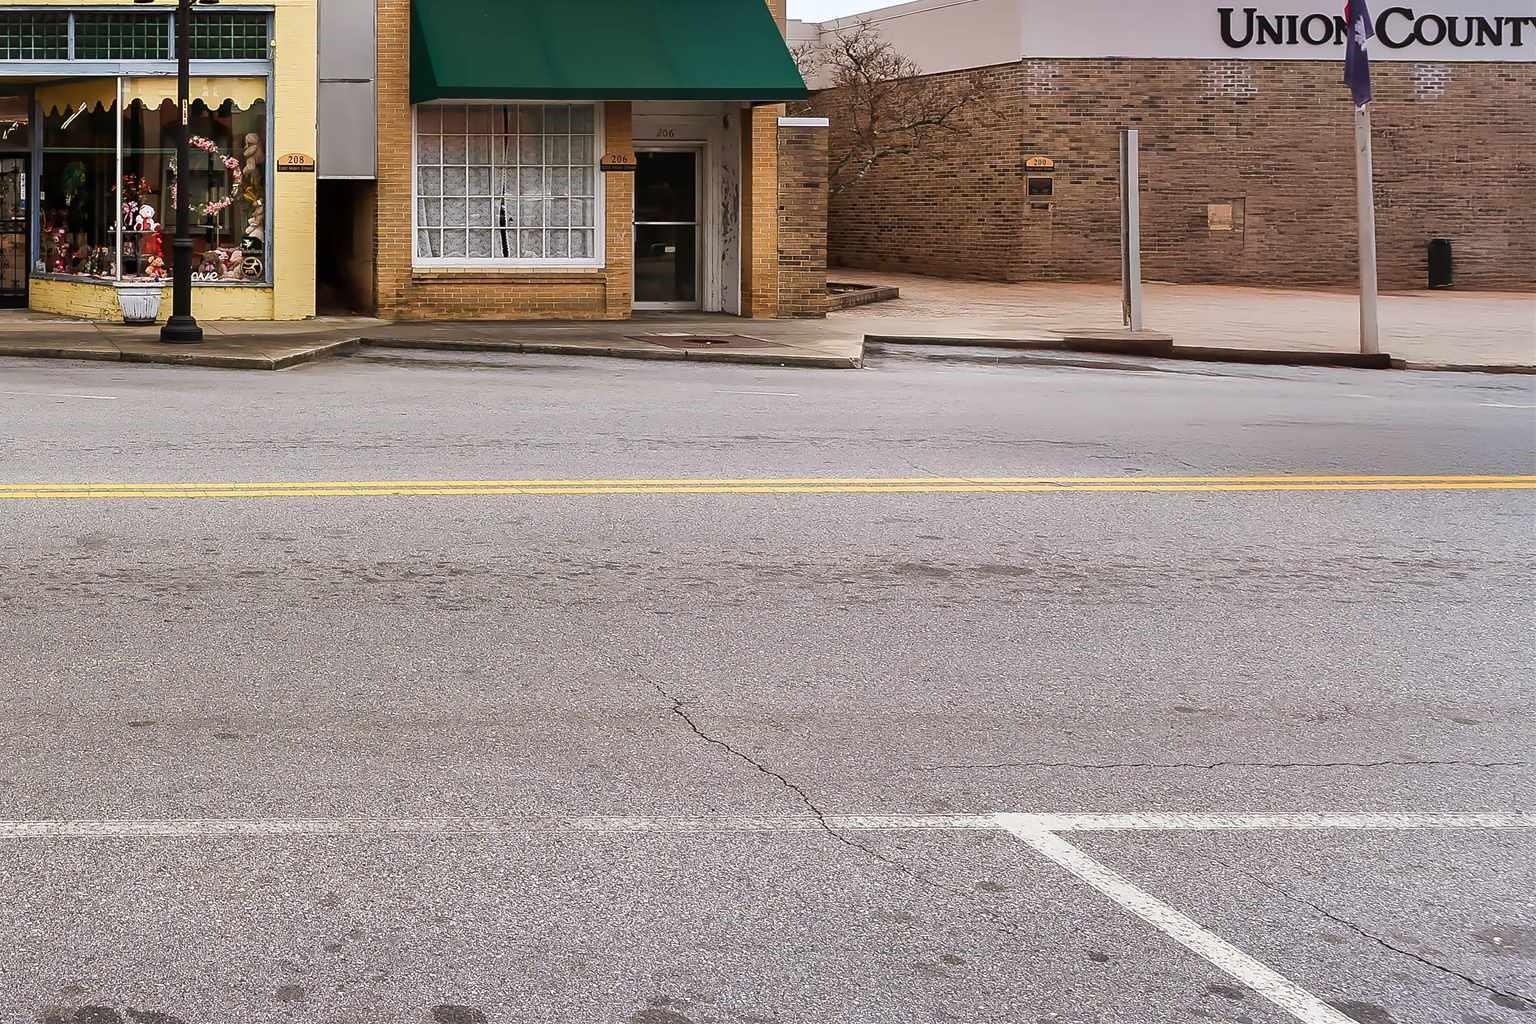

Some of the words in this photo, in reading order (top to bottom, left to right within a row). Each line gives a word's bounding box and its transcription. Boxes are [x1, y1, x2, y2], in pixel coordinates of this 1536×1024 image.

[288, 155, 304, 164] 208
[611, 154, 628, 163] 206
[190, 271, 219, 281] ove
